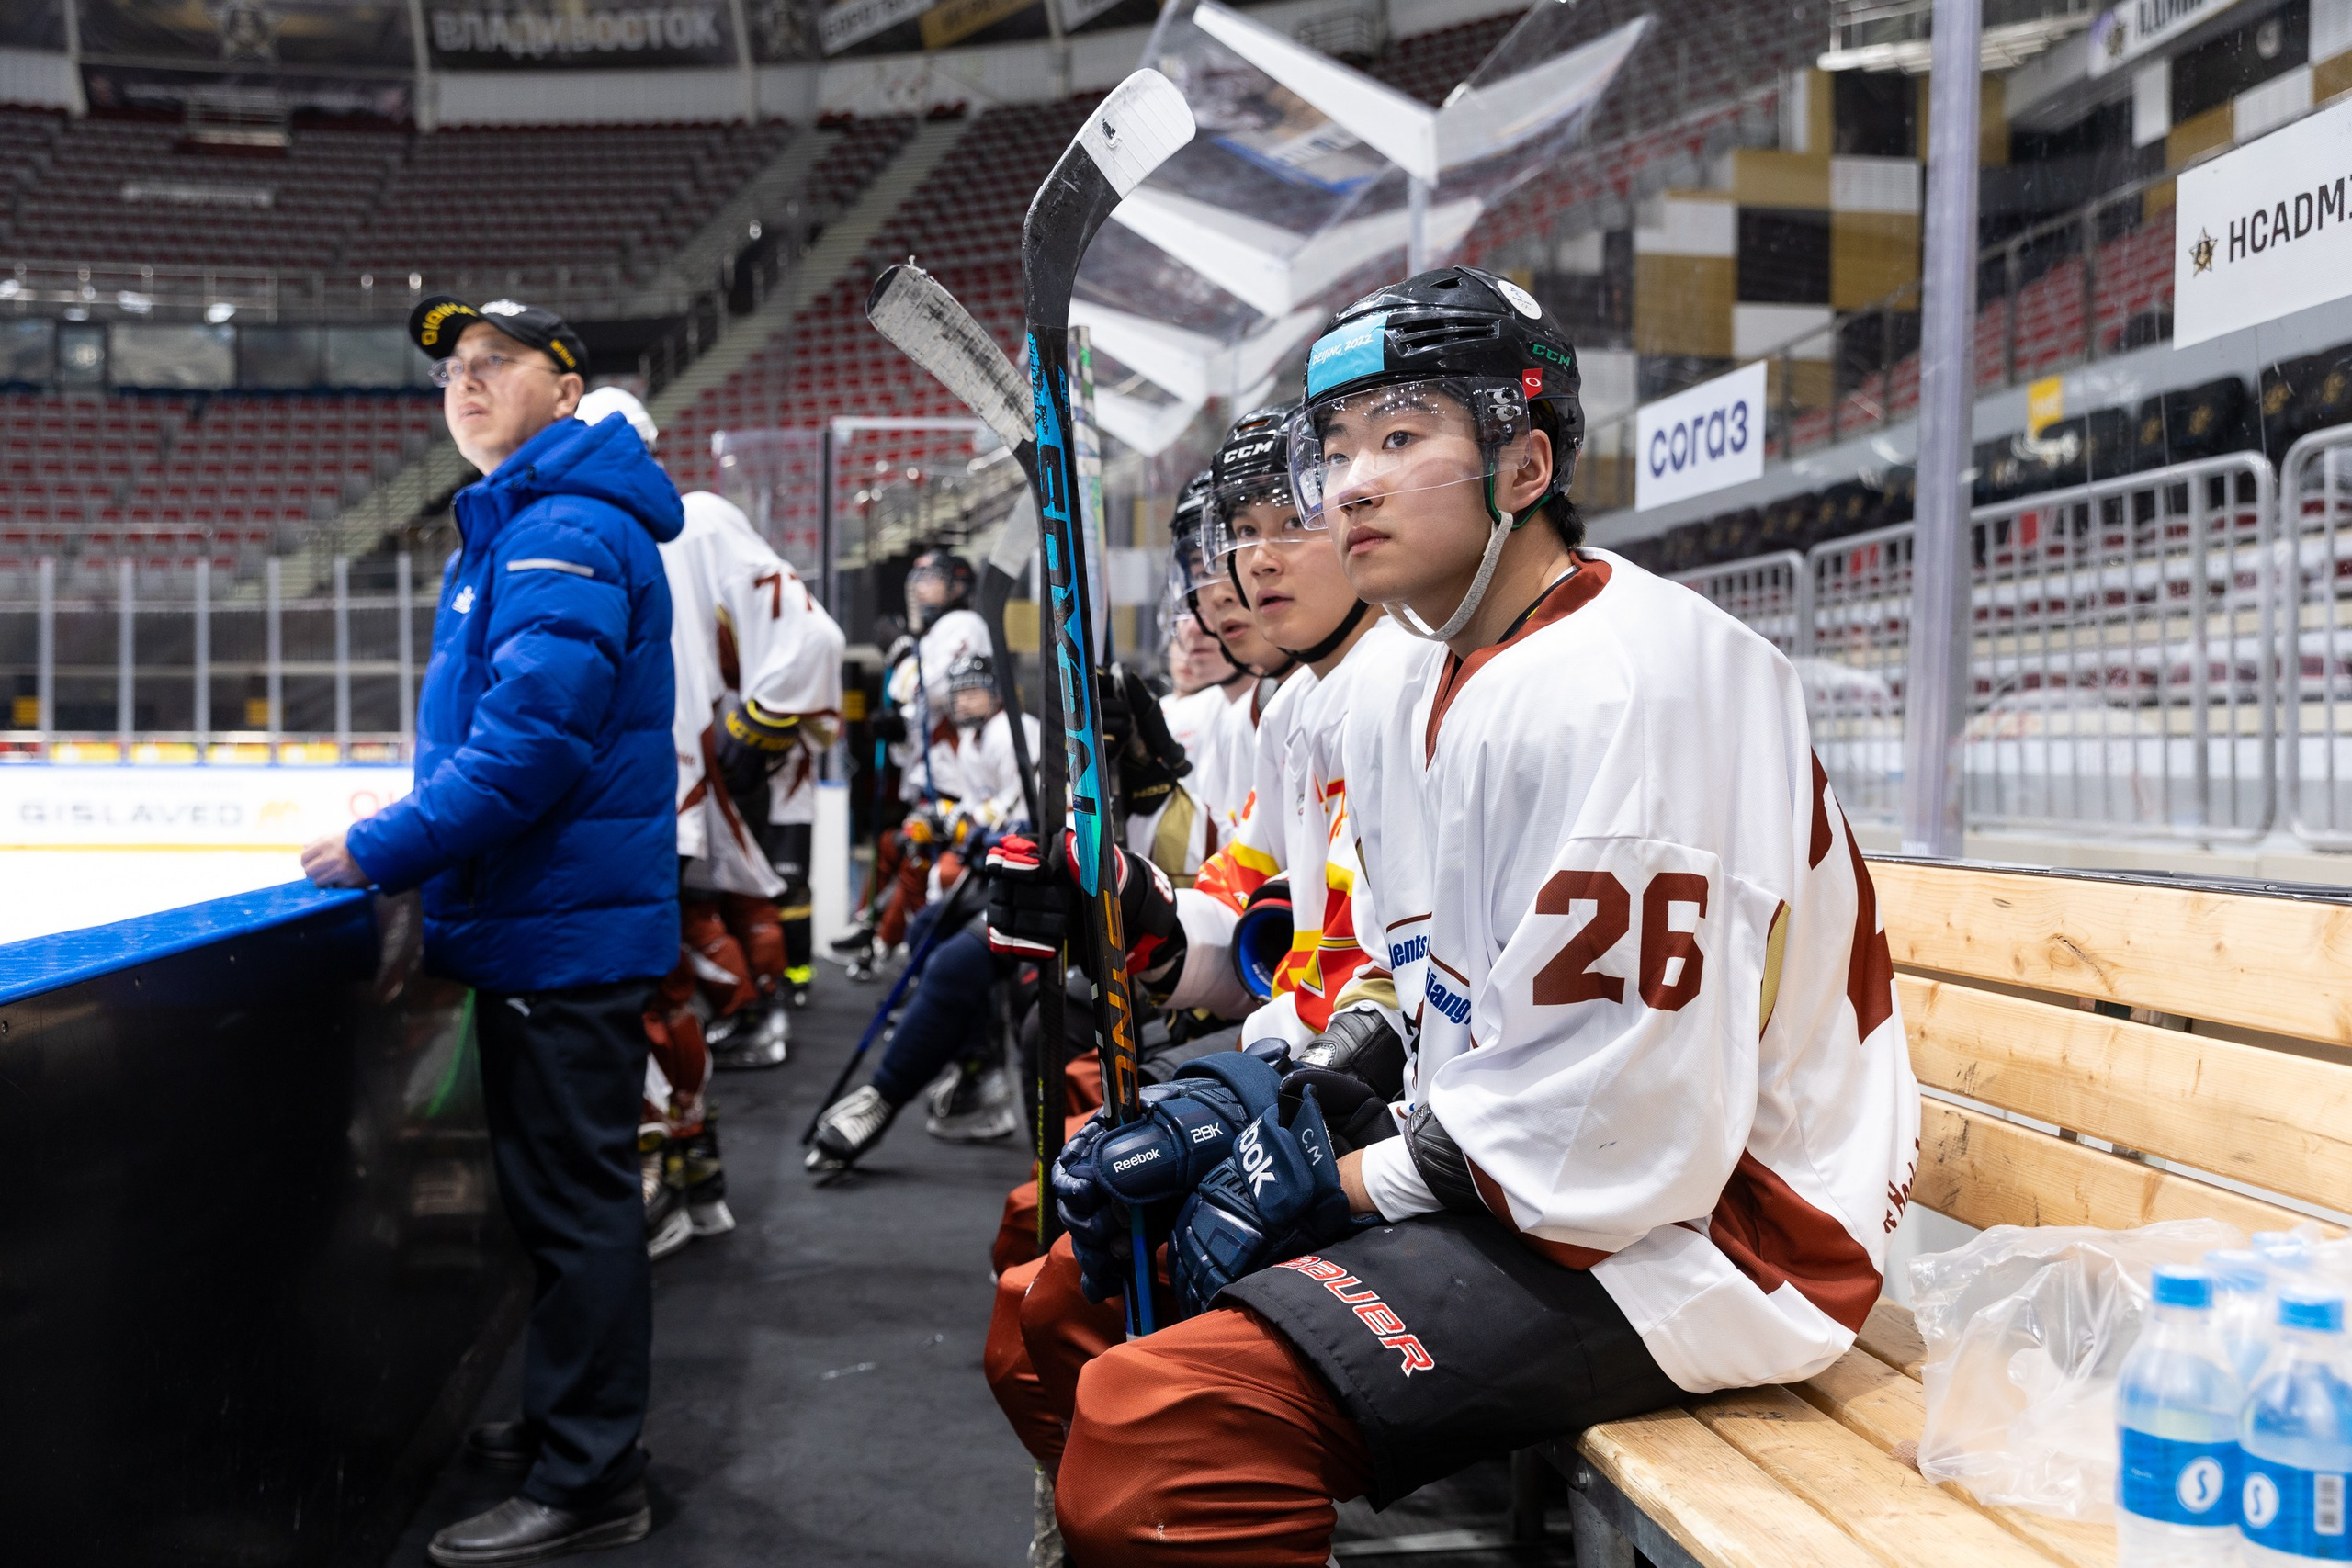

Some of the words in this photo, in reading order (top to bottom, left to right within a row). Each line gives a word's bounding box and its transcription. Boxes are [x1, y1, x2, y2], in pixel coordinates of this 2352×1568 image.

[2229, 175, 2352, 263] HCADM
[1344, 333, 1374, 352] 2022
[1532, 344, 1571, 367] CCM
[1224, 440, 1274, 464] CCM
[1388, 934, 1427, 971] ents
[1532, 869, 1710, 1012] 26
[1103, 889, 1141, 1114] SYNC
[1190, 1122, 1224, 1144] 28K
[1113, 1148, 1161, 1173] Reebok
[1239, 1116, 1276, 1198] bok
